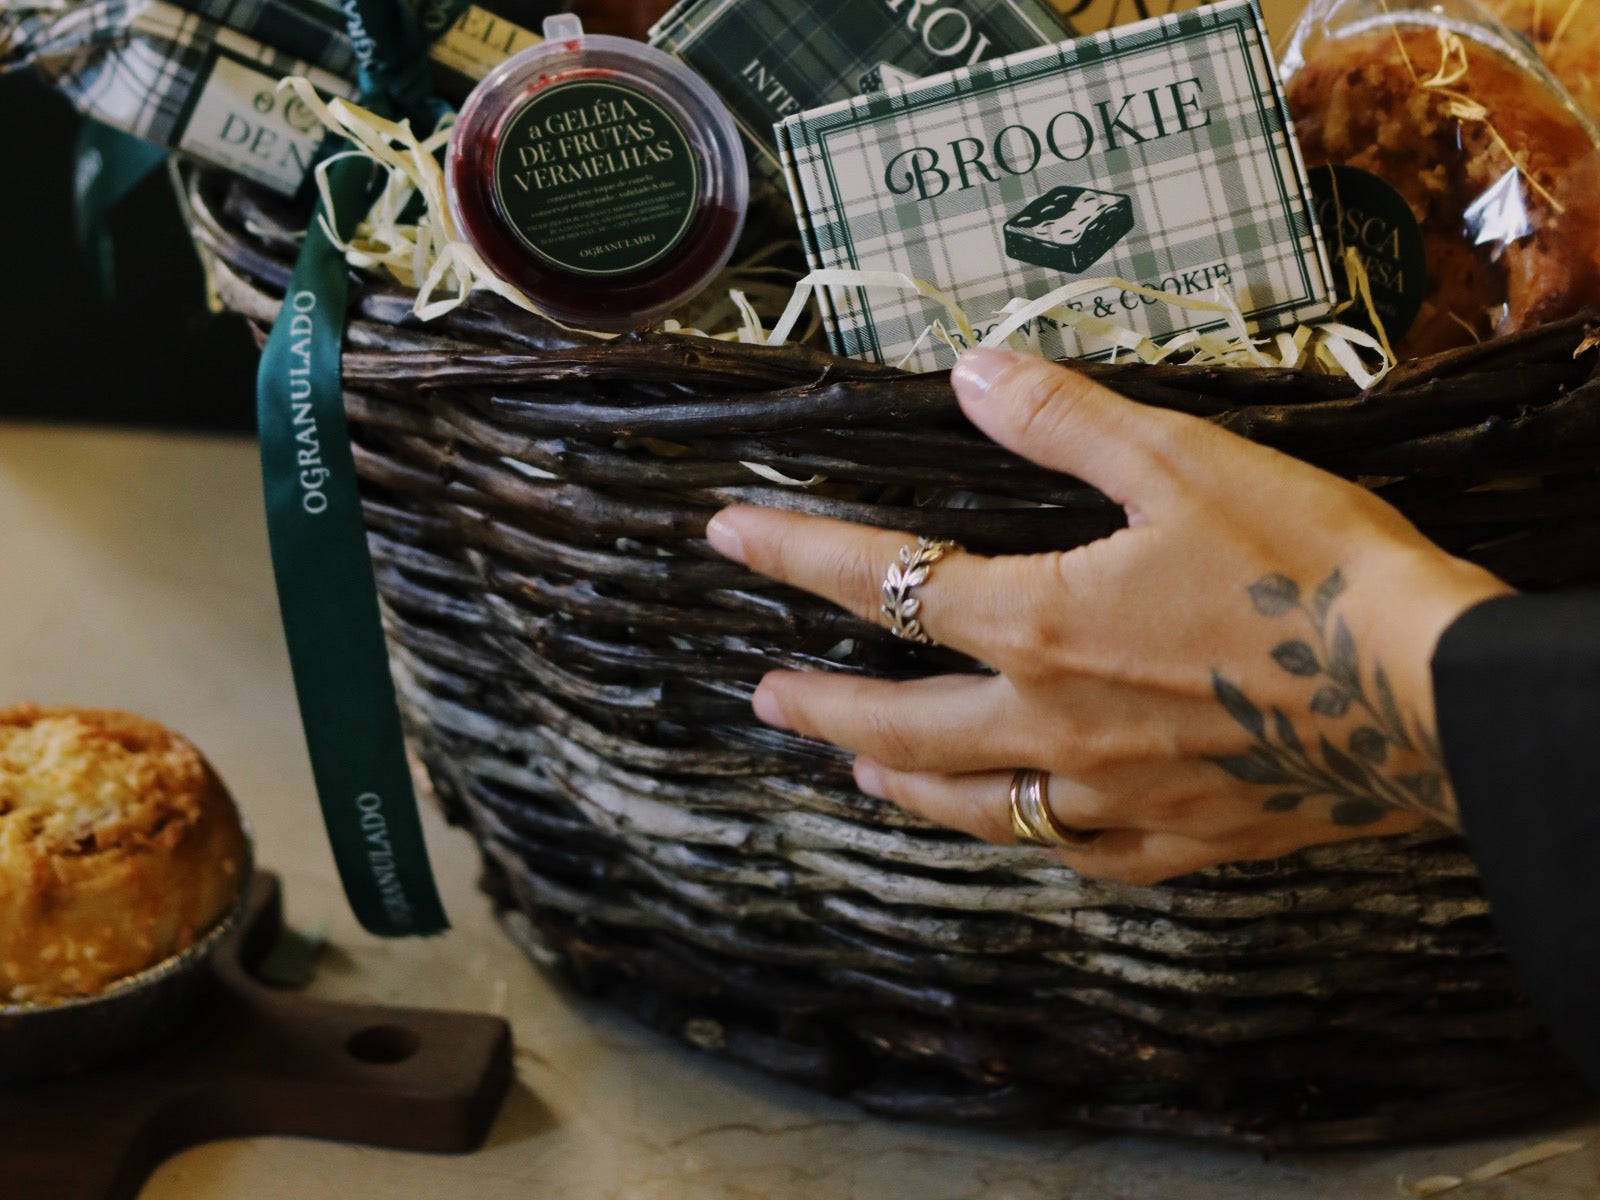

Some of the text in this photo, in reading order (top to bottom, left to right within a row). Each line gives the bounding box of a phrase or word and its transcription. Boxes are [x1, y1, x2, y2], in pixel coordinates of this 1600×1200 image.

[518, 118, 656, 168] DE FRUTAS
[528, 98, 639, 140] a GELÉIA
[883, 76, 1213, 202] BROOKIE
[513, 139, 675, 193] VERMELHAS
[579, 232, 657, 258] OGRANULADO
[1093, 294, 1119, 319] &
[1119, 262, 1233, 311] COOKIE
[290, 290, 331, 516] OGRANULADO
